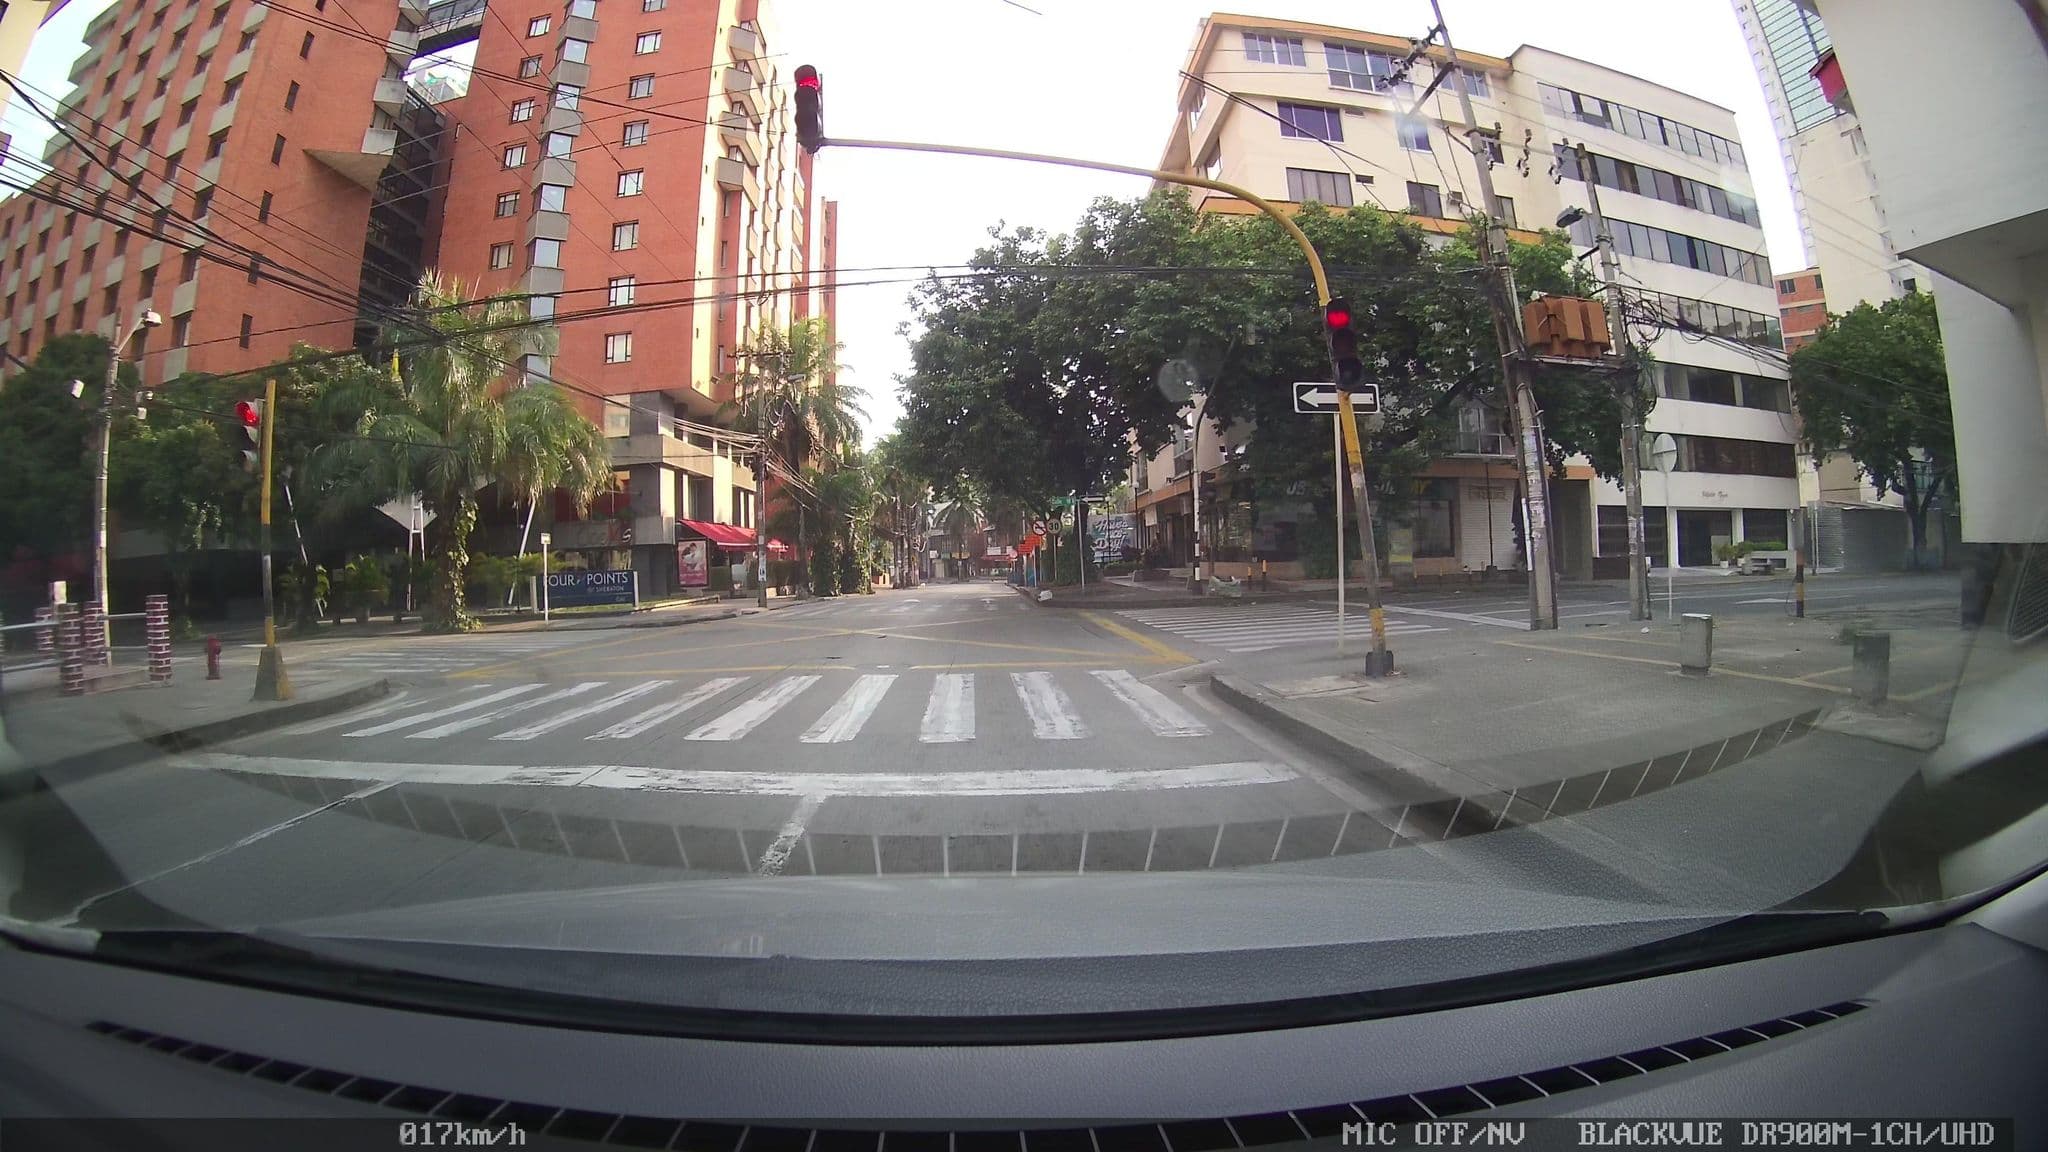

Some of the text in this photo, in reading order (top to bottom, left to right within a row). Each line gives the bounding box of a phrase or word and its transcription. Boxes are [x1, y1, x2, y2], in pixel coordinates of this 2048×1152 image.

[1049, 522, 1059, 531] 30
[544, 571, 629, 587] OUR POINTS
